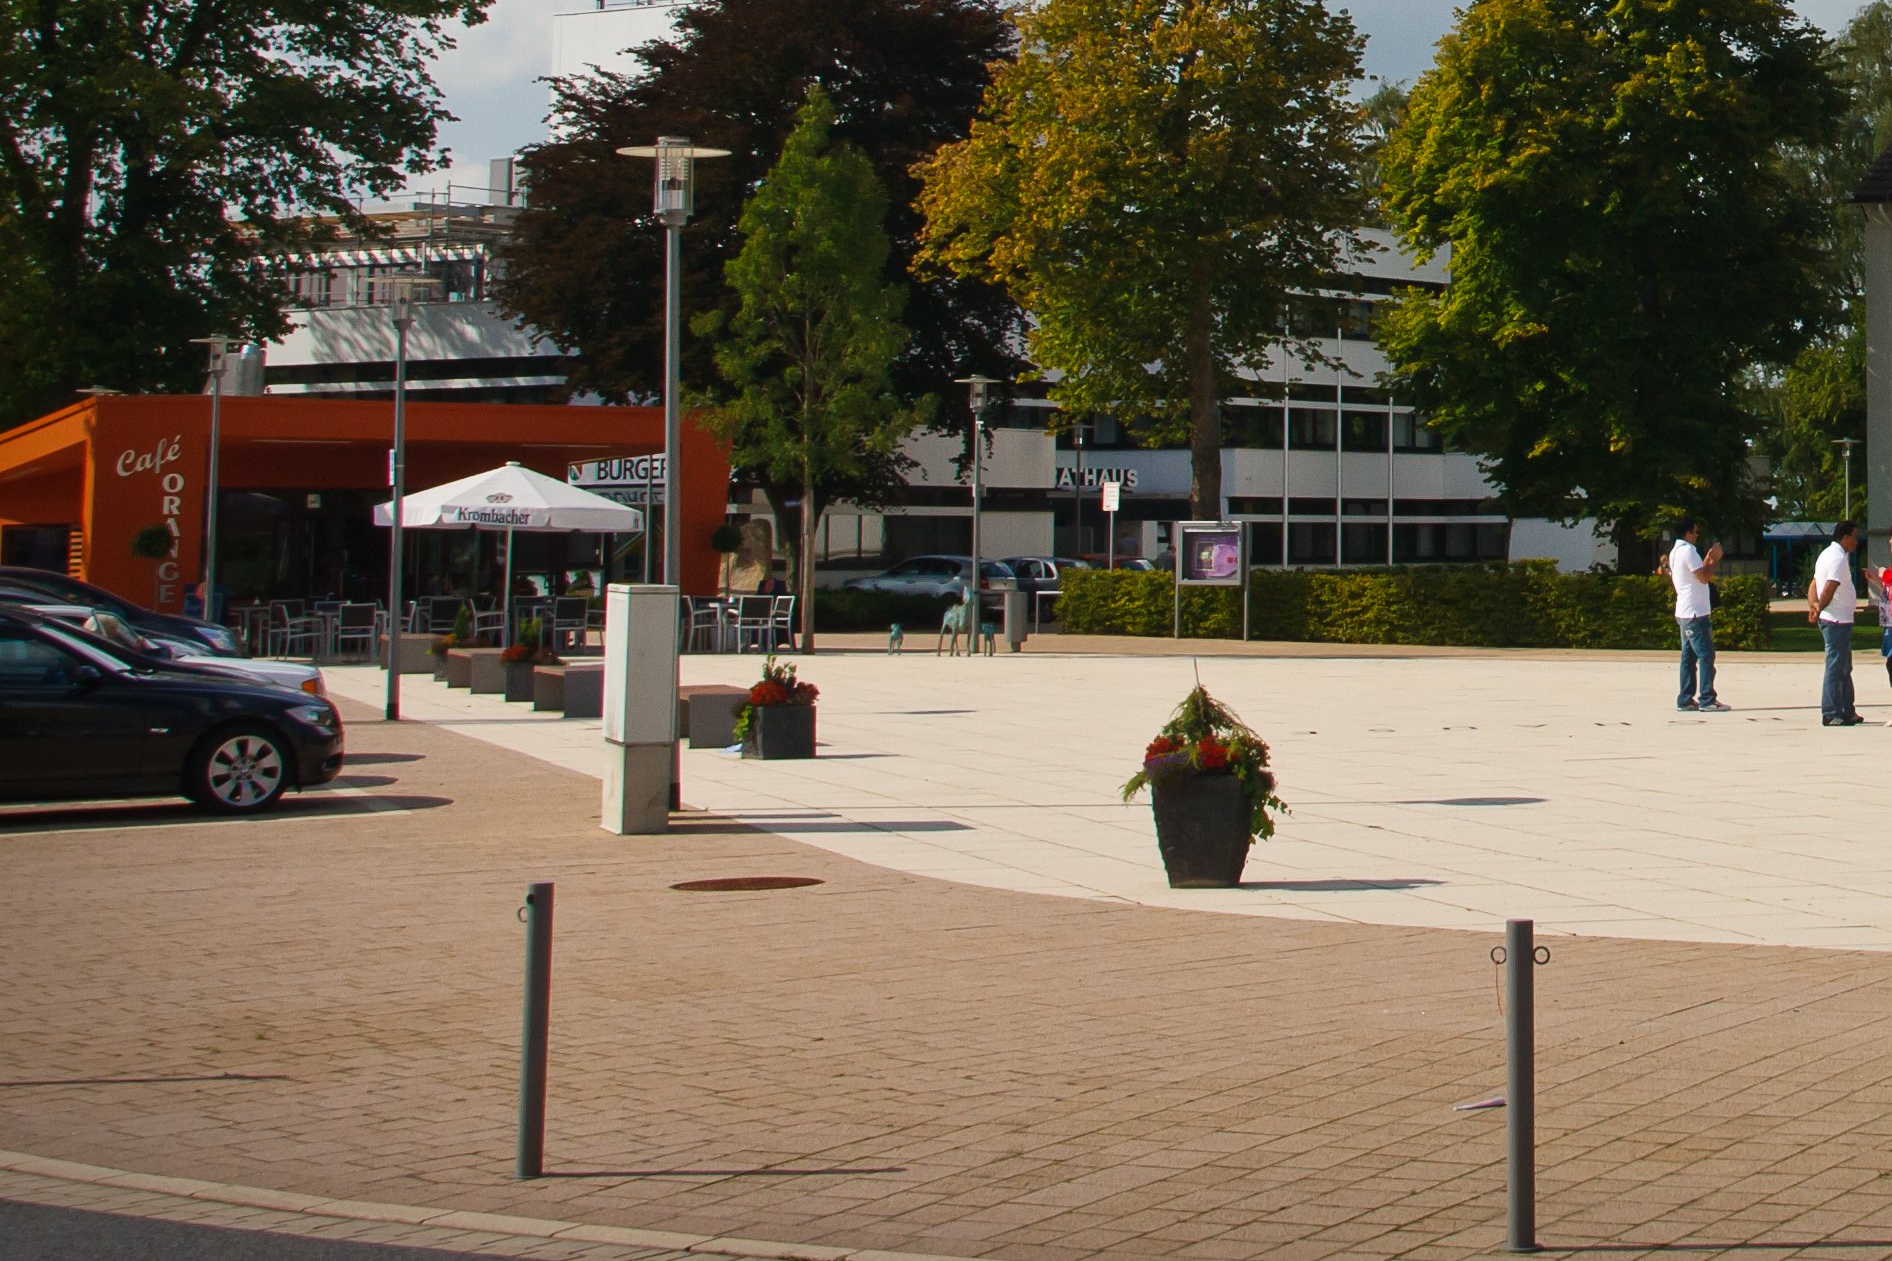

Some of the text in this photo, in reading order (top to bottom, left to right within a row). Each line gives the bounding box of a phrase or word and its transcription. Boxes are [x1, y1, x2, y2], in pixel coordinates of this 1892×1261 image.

[116, 434, 182, 477] Café
[1056, 467, 1139, 488] ATHAUS
[457, 507, 531, 525] Krombacher
